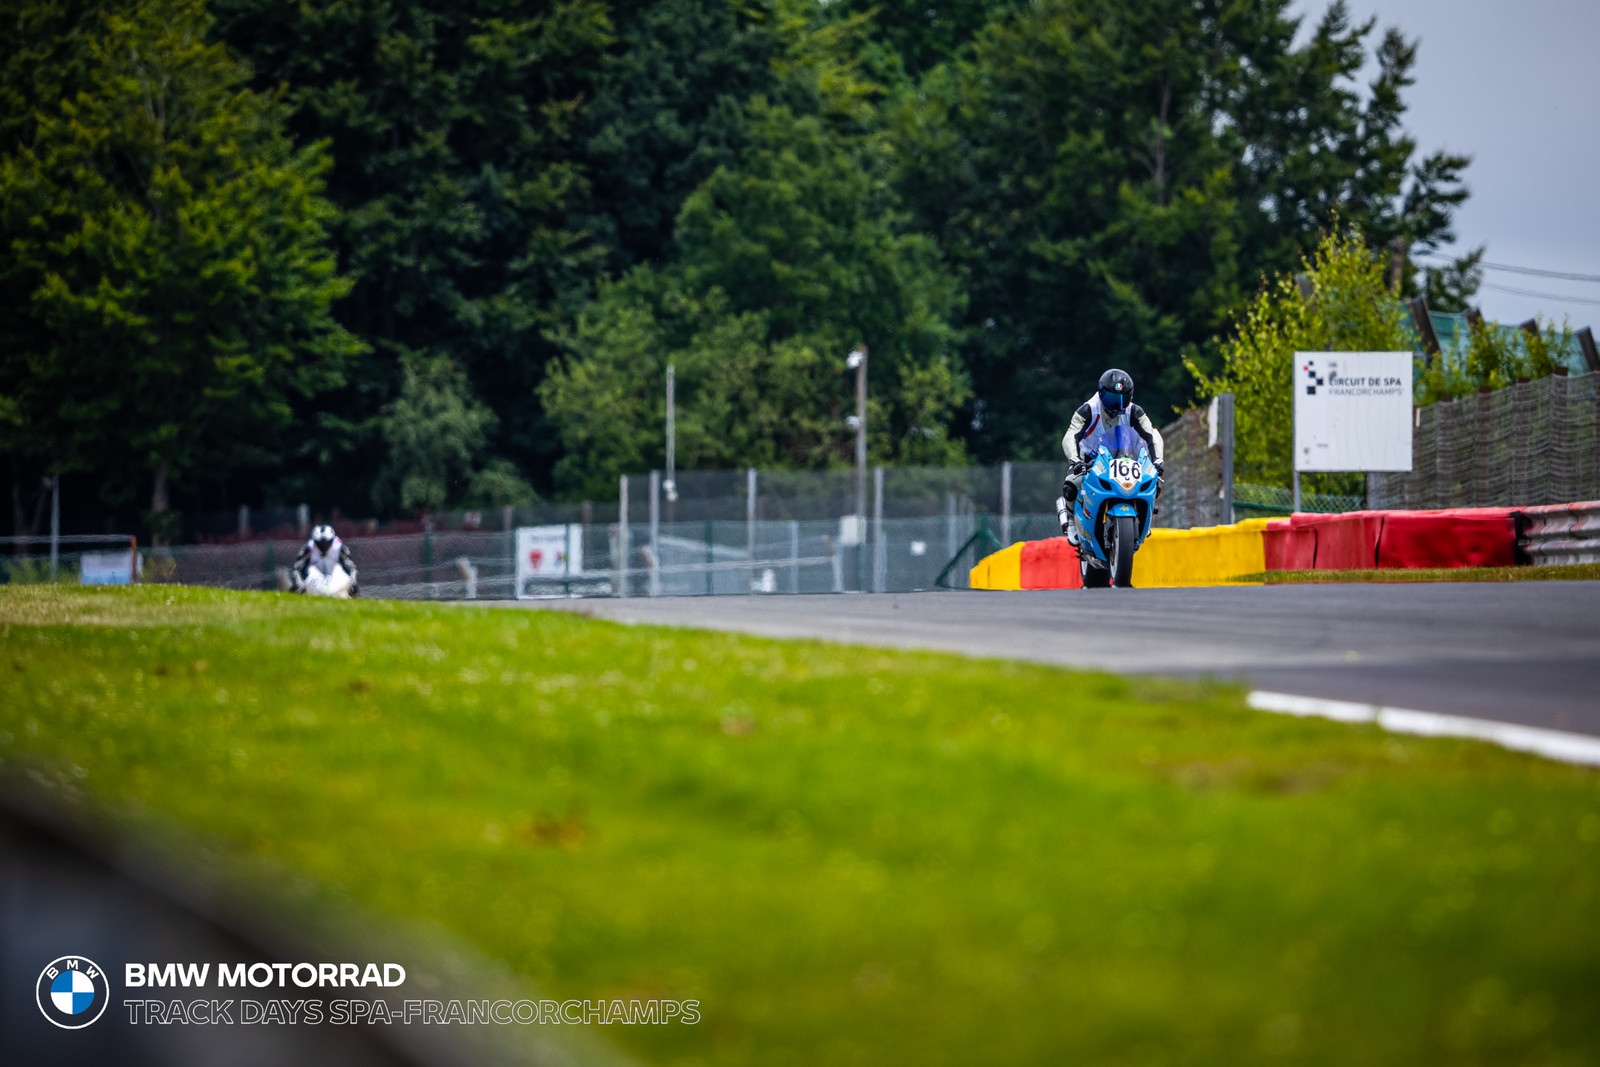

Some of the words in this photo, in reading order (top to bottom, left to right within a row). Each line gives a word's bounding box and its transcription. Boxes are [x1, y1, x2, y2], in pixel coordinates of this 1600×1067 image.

[1368, 377, 1381, 387] DE
[1383, 377, 1402, 387] SPA
[1110, 459, 1141, 480] 166
